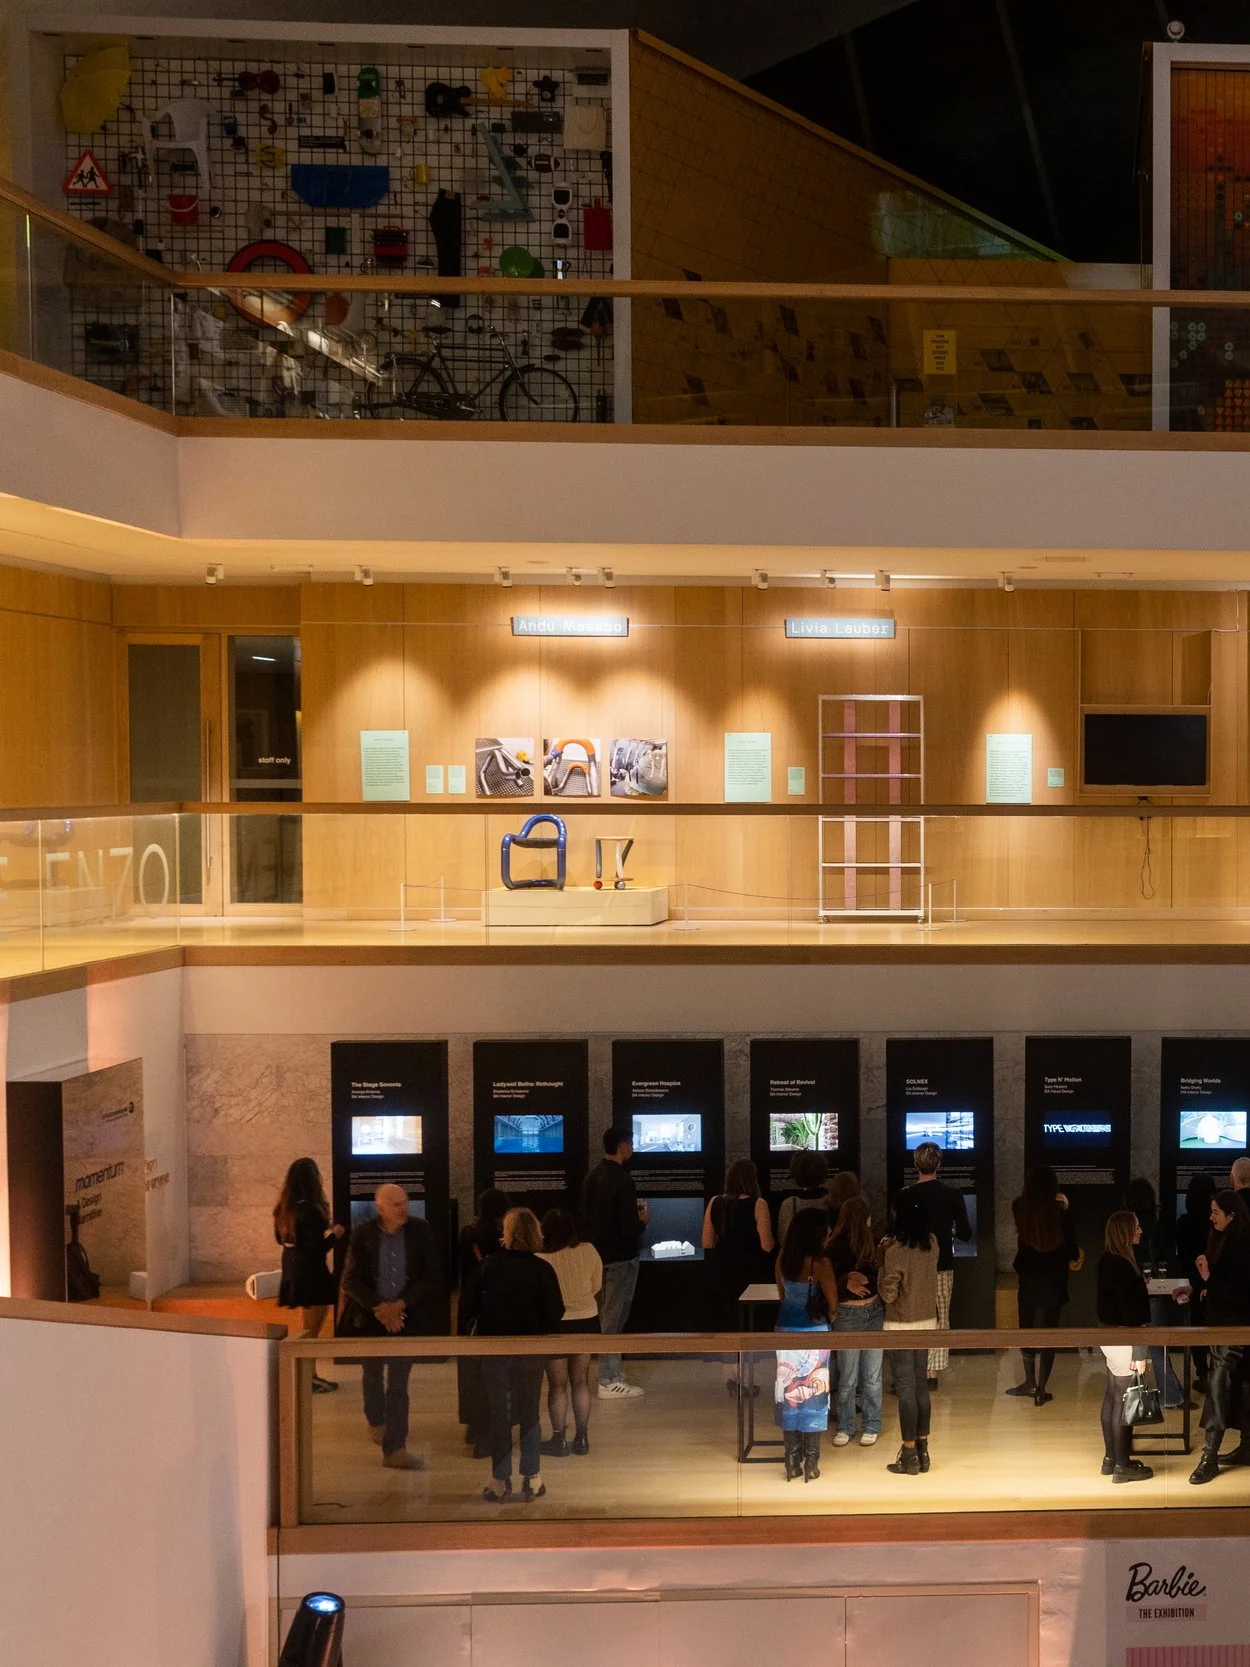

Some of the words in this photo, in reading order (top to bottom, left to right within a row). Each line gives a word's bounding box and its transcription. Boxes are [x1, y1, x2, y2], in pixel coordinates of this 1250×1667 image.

[518, 619, 554, 631] Andu
[791, 621, 828, 633] Livia
[835, 621, 889, 634] Lauber
[275, 757, 291, 765] only
[1043, 1124, 1064, 1133] TYPE
[75, 1161, 124, 1192] momentum
[1126, 1562, 1206, 1602] Barbie
[1139, 1608, 1152, 1619] THE
[1154, 1607, 1195, 1619] EXHIBITION
